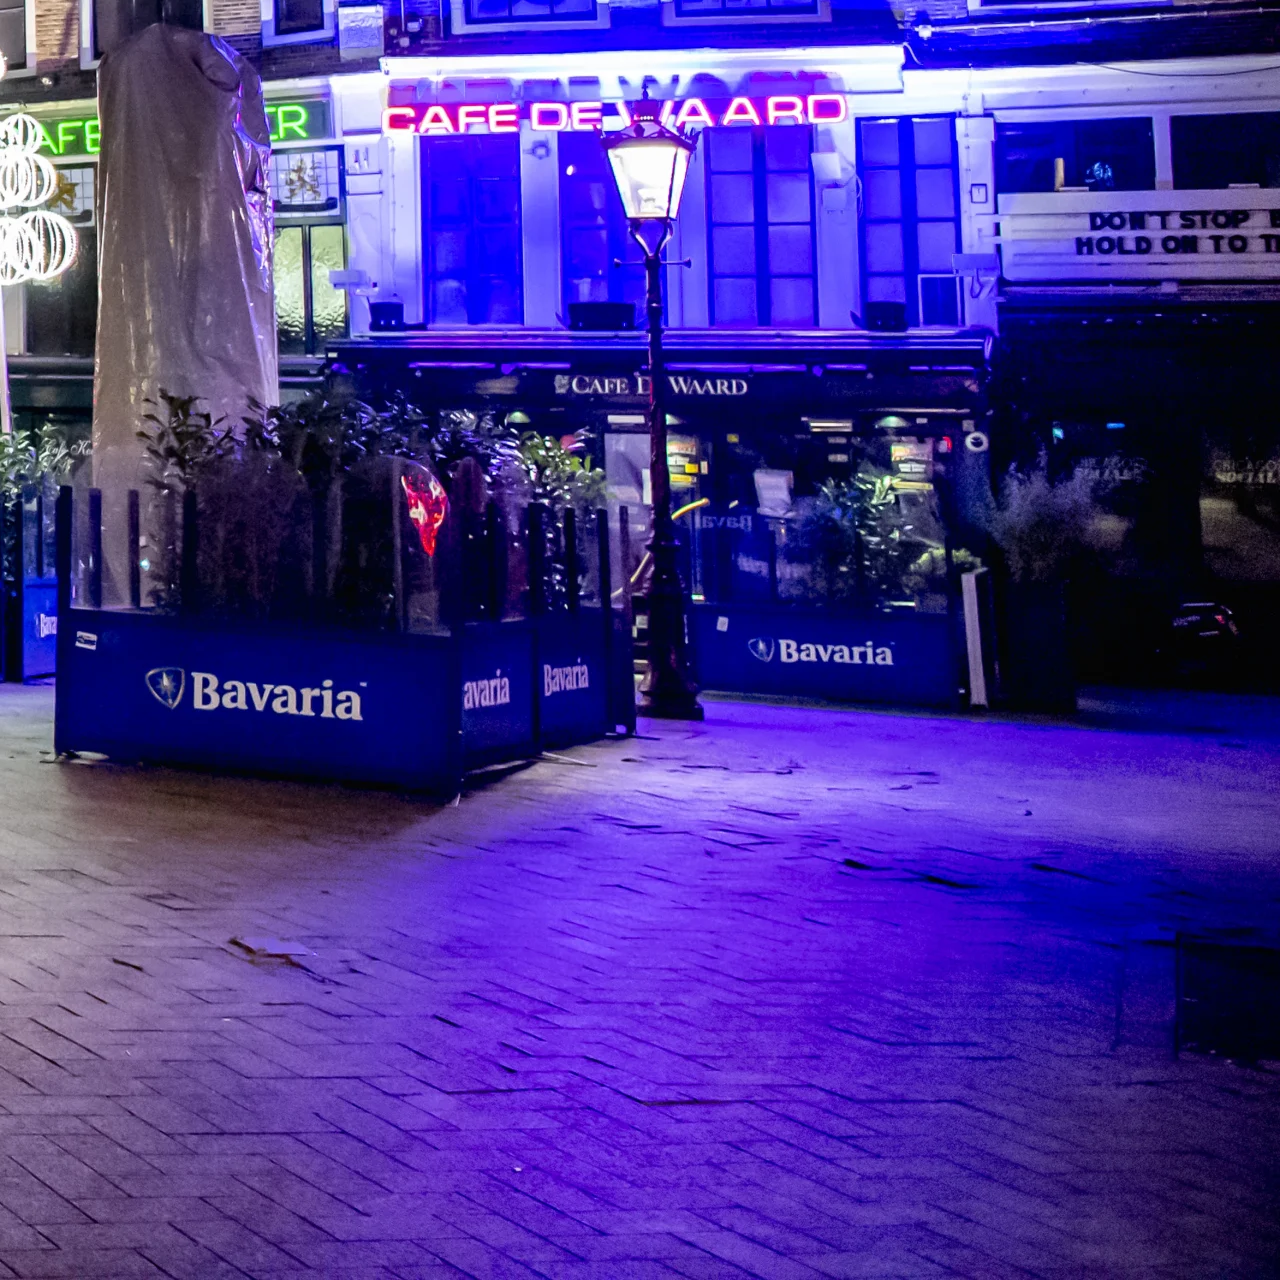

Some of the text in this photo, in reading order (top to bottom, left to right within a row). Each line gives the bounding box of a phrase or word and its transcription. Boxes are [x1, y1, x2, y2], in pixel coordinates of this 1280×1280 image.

[381, 102, 519, 134] CAFE
[530, 100, 602, 131] DE
[1179, 210, 1251, 229] STOP
[1075, 236, 1152, 255] HOLD
[1161, 234, 1198, 254] ON
[1208, 234, 1248, 254] TO
[571, 375, 629, 394] CAFE
[667, 375, 748, 395] WAARD
[779, 637, 894, 666] Bavaria
[463, 668, 511, 710] avaria
[543, 657, 589, 697] Bavaria
[191, 672, 364, 721] Bavaria
